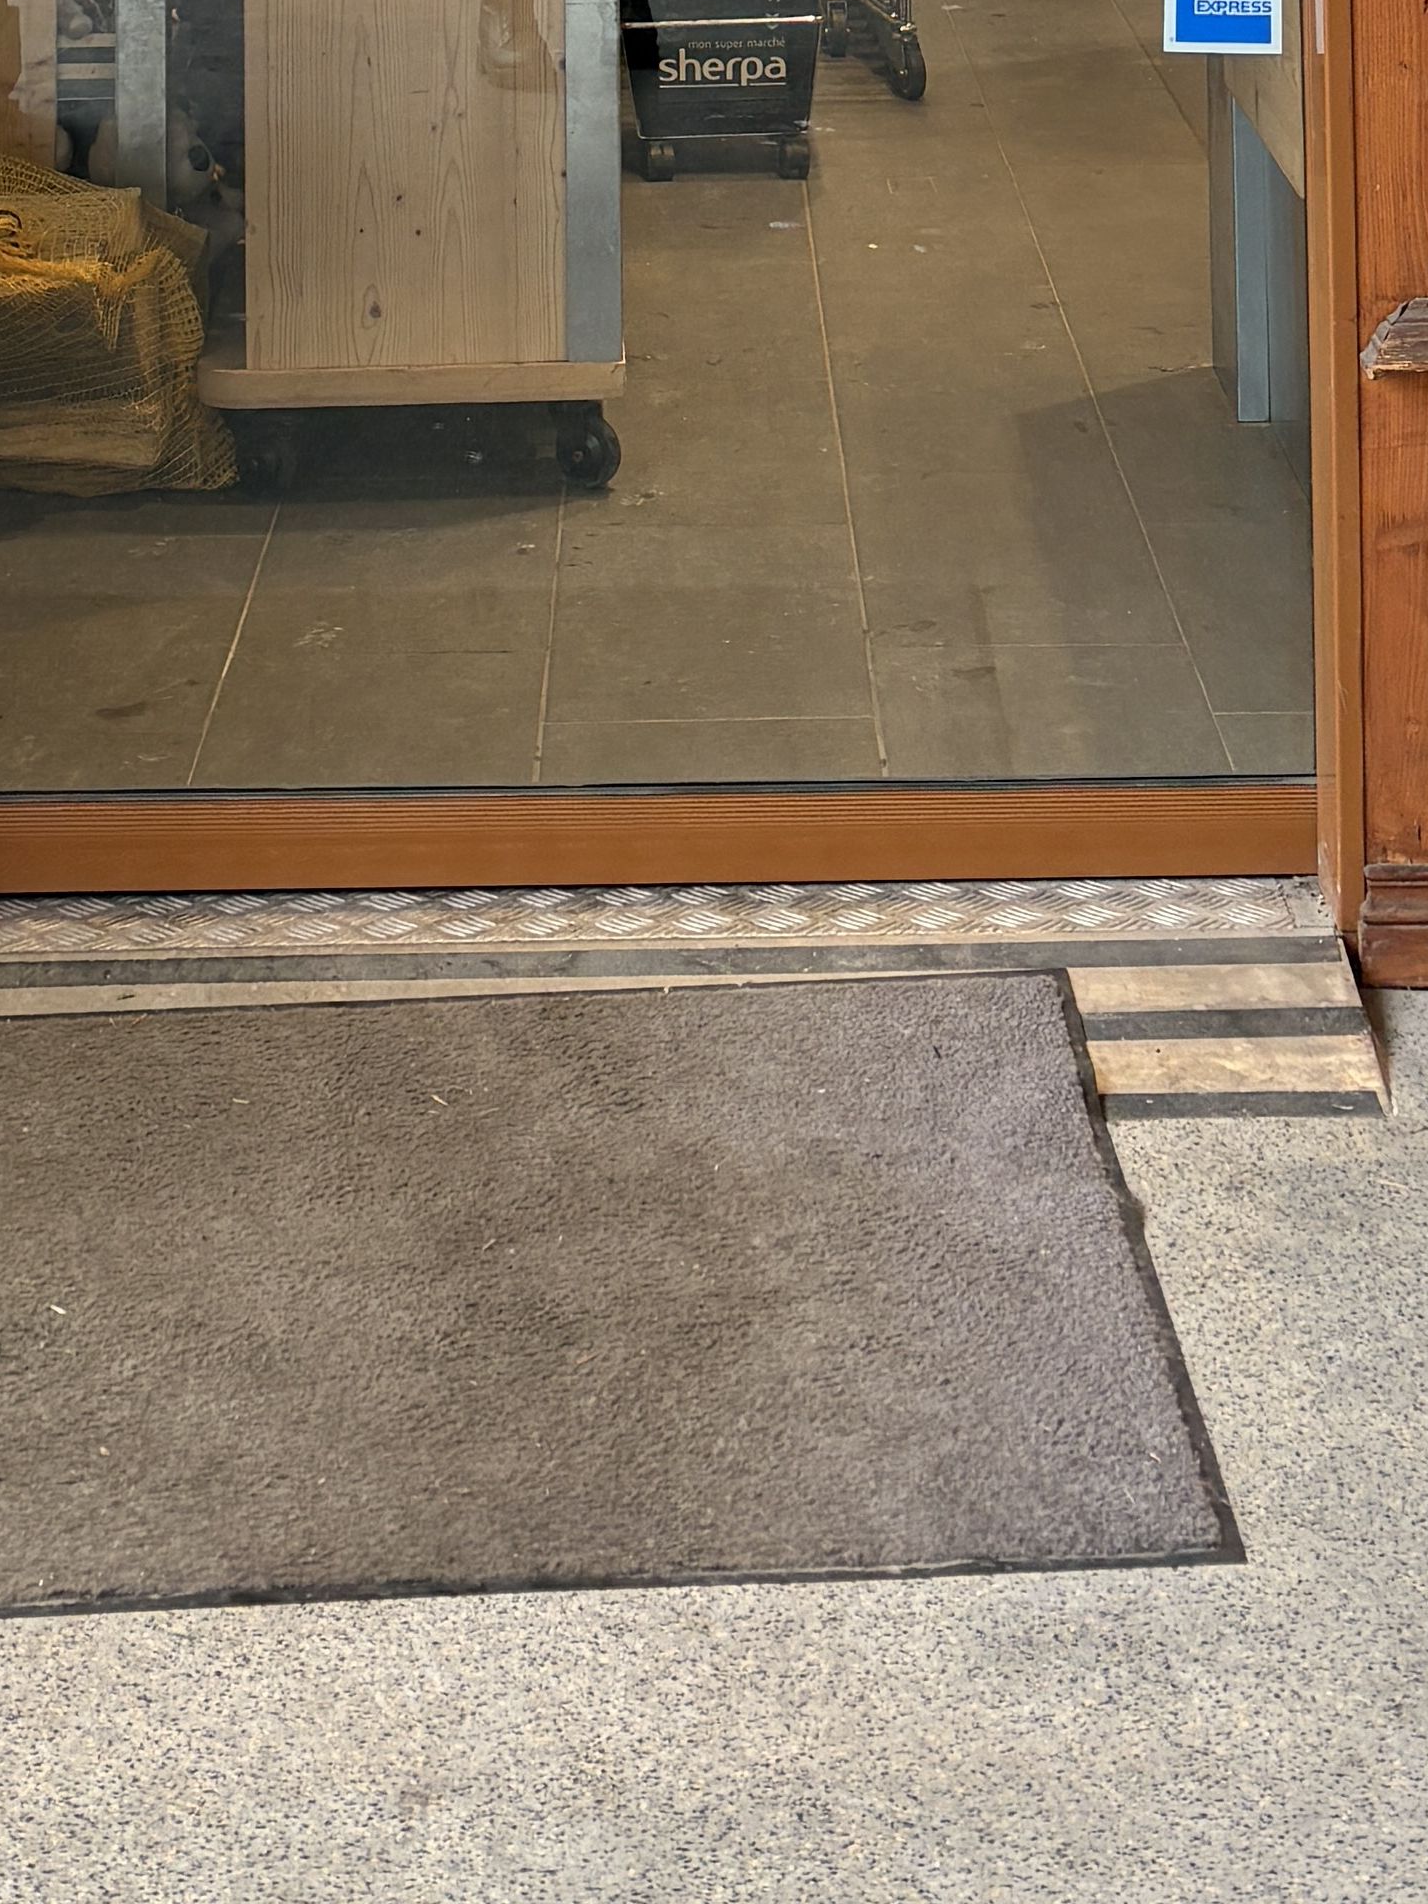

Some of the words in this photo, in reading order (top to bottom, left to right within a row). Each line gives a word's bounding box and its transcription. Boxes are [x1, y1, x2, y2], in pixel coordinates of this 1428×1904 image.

[1196, 0, 1272, 14] EXPRESS
[688, 40, 712, 50] mon
[715, 40, 743, 51] super
[746, 36, 786, 48] marché
[658, 47, 787, 87] sherpa
